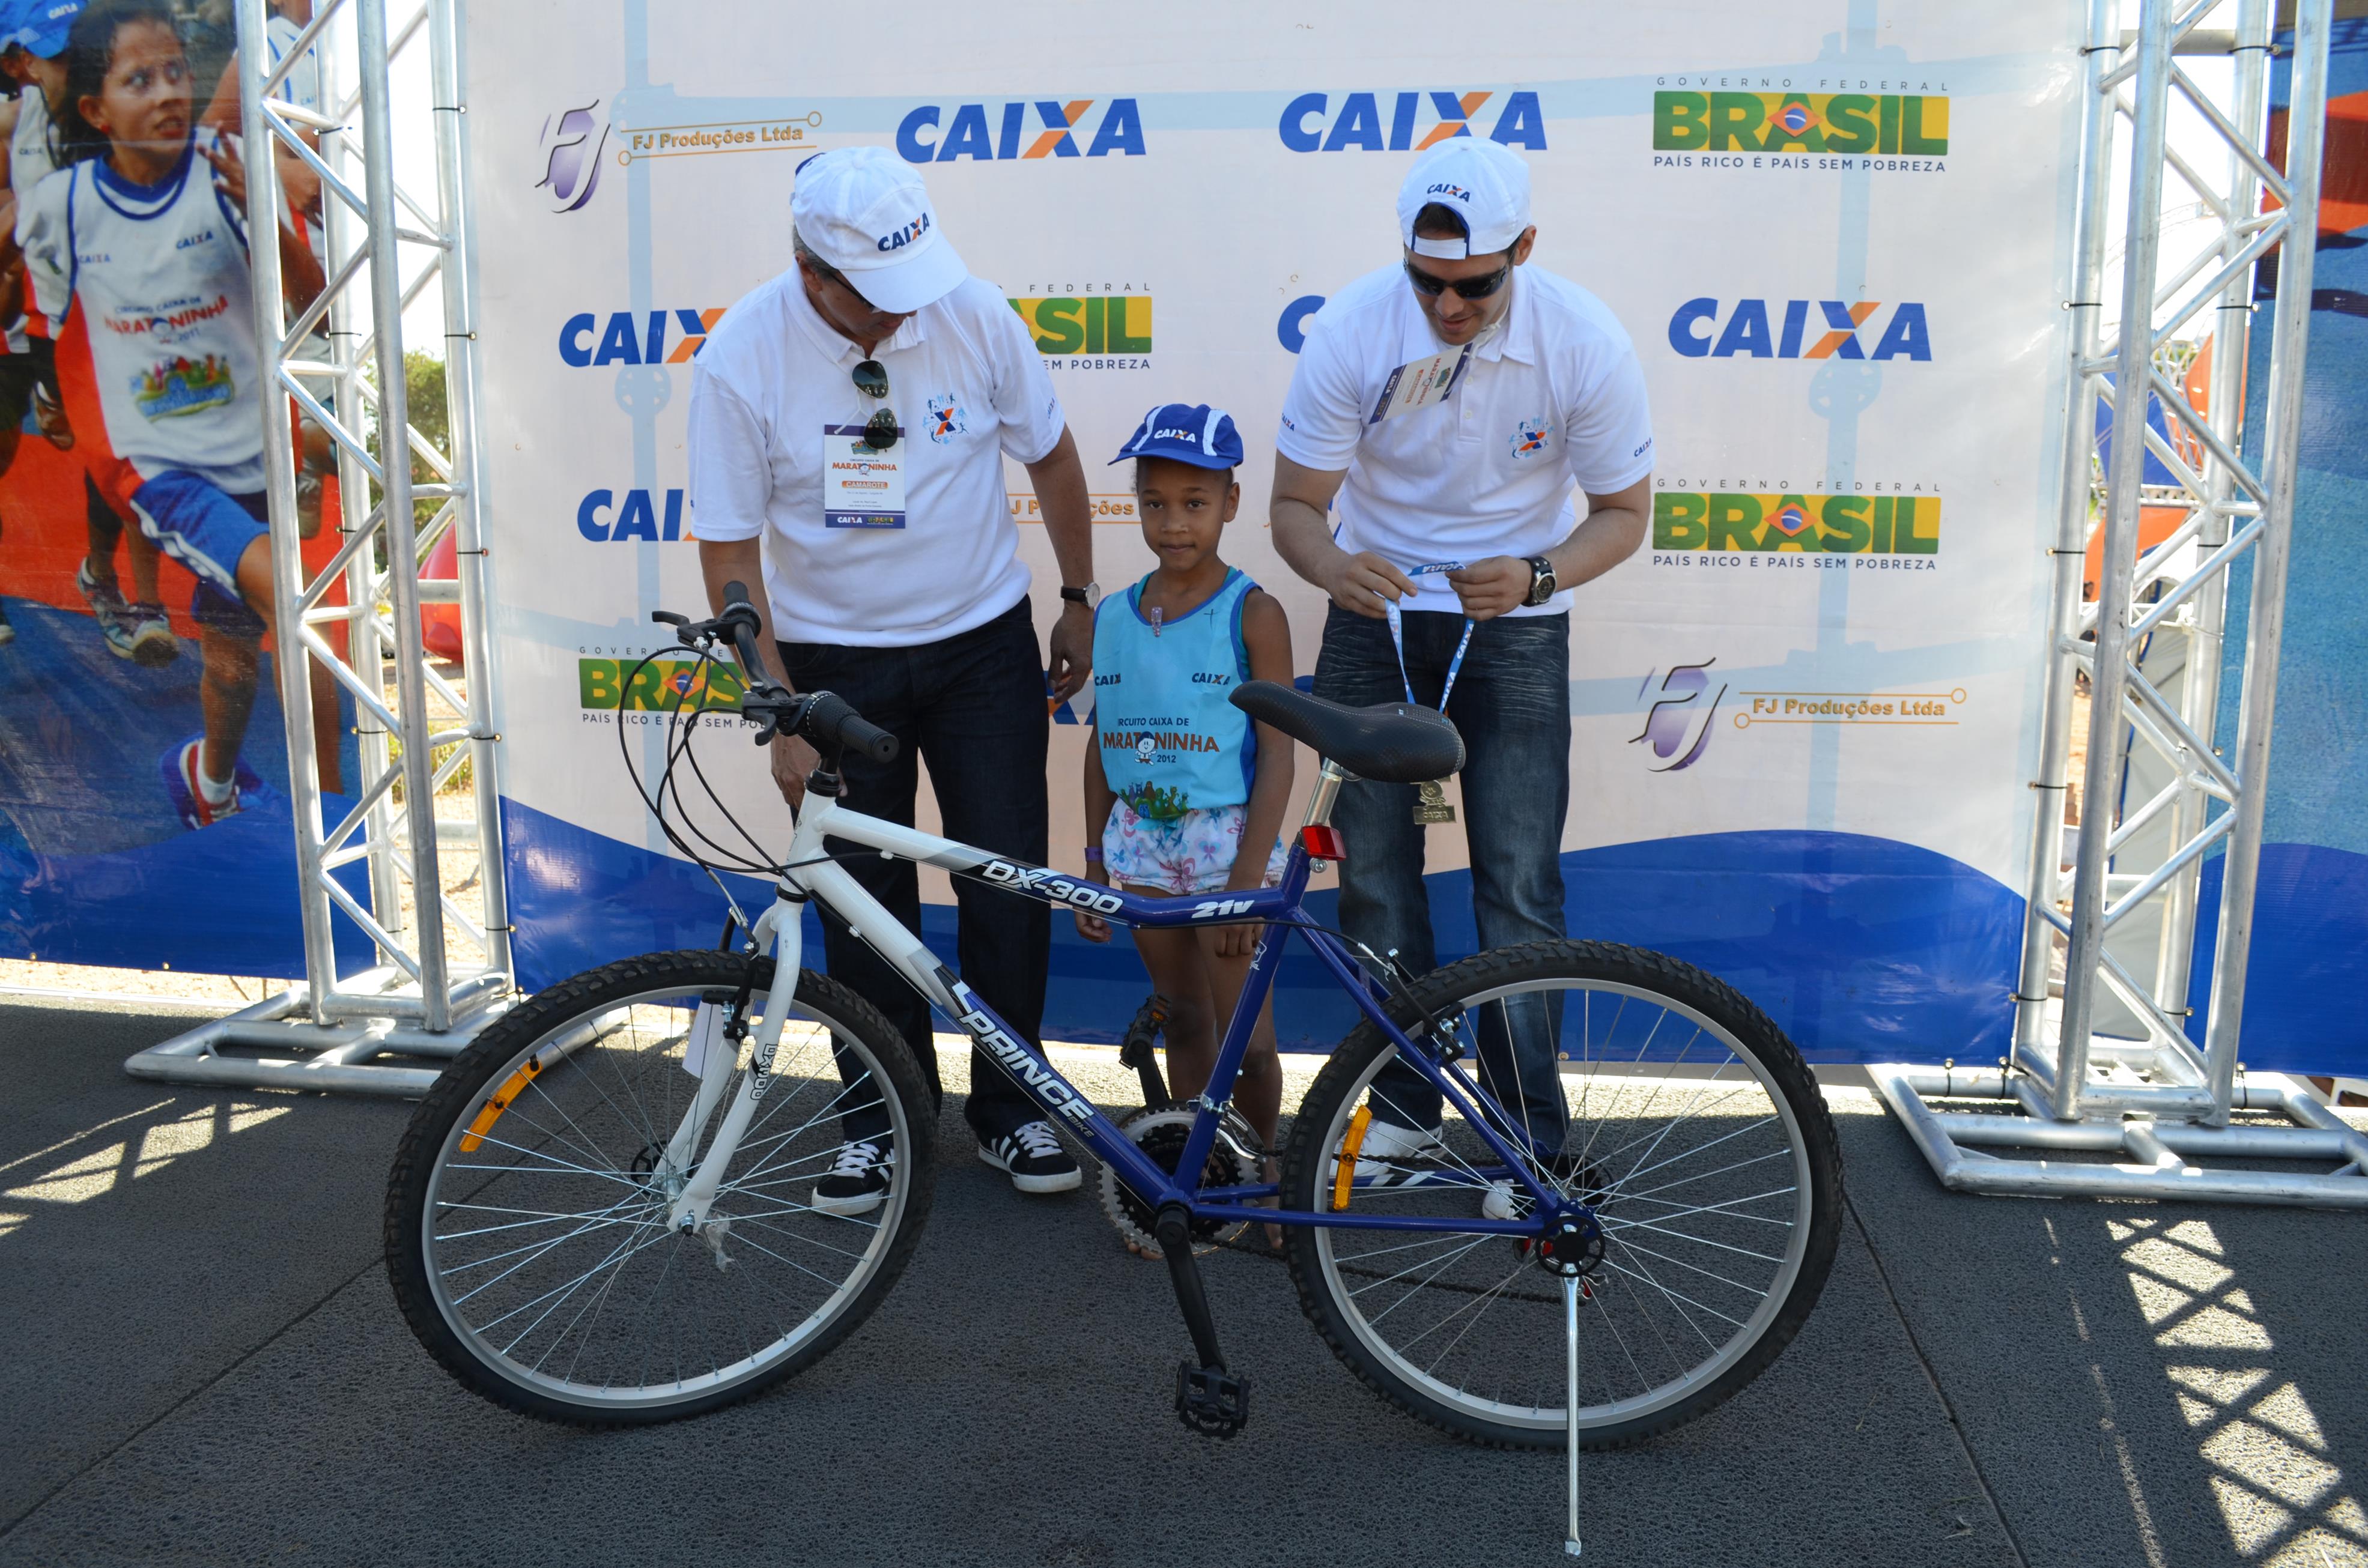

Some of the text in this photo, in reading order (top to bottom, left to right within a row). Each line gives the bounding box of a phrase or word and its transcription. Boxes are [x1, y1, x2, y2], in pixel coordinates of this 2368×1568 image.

[1657, 76, 1948, 91] GOVERNO FEDERAL
[895, 97, 1146, 163] CAIXA
[1278, 91, 1548, 153] CAIXA
[1653, 90, 1950, 156] BRASIL
[633, 125, 804, 150] FJ Produções Ltda
[1654, 154, 1946, 172] PAÍS RICO É PAÍS SEM POBREZA
[1427, 183, 1471, 202] CAIXA
[177, 231, 214, 250] CAIXA
[877, 211, 931, 252] CAIXA
[1029, 282, 1150, 293] FEDERAL
[1007, 295, 1152, 356] SIL
[1668, 297, 1933, 362] CAIXA
[557, 306, 728, 368] CAIX
[1071, 359, 1150, 370] POBREZA
[1153, 428, 1197, 443] CAIXA
[1657, 479, 1941, 492] GOVERNO FEDERAL
[577, 488, 699, 543] CAI
[1010, 499, 1022, 515] J
[1652, 492, 1942, 555] BRASIL
[1653, 554, 1937, 571] PAÍS RICO É PAÍS SEM POBREZA
[579, 646, 680, 656] GOVERO
[578, 658, 751, 714] BRAS
[1191, 672, 1231, 686] CAIXA
[1753, 698, 1946, 719] FJ Produções Ltda
[582, 712, 610, 724] PAÍS
[655, 715, 663, 725] É
[705, 718, 732, 728] SEM
[1149, 717, 1173, 726] CAIXA
[1176, 717, 1189, 726] DE
[1157, 754, 1176, 763] 2012
[982, 860, 1123, 914] DX-300
[750, 1043, 779, 1101] DX300
[959, 1010, 1094, 1119] PRINCE
[1067, 1116, 1095, 1138] BIKE
